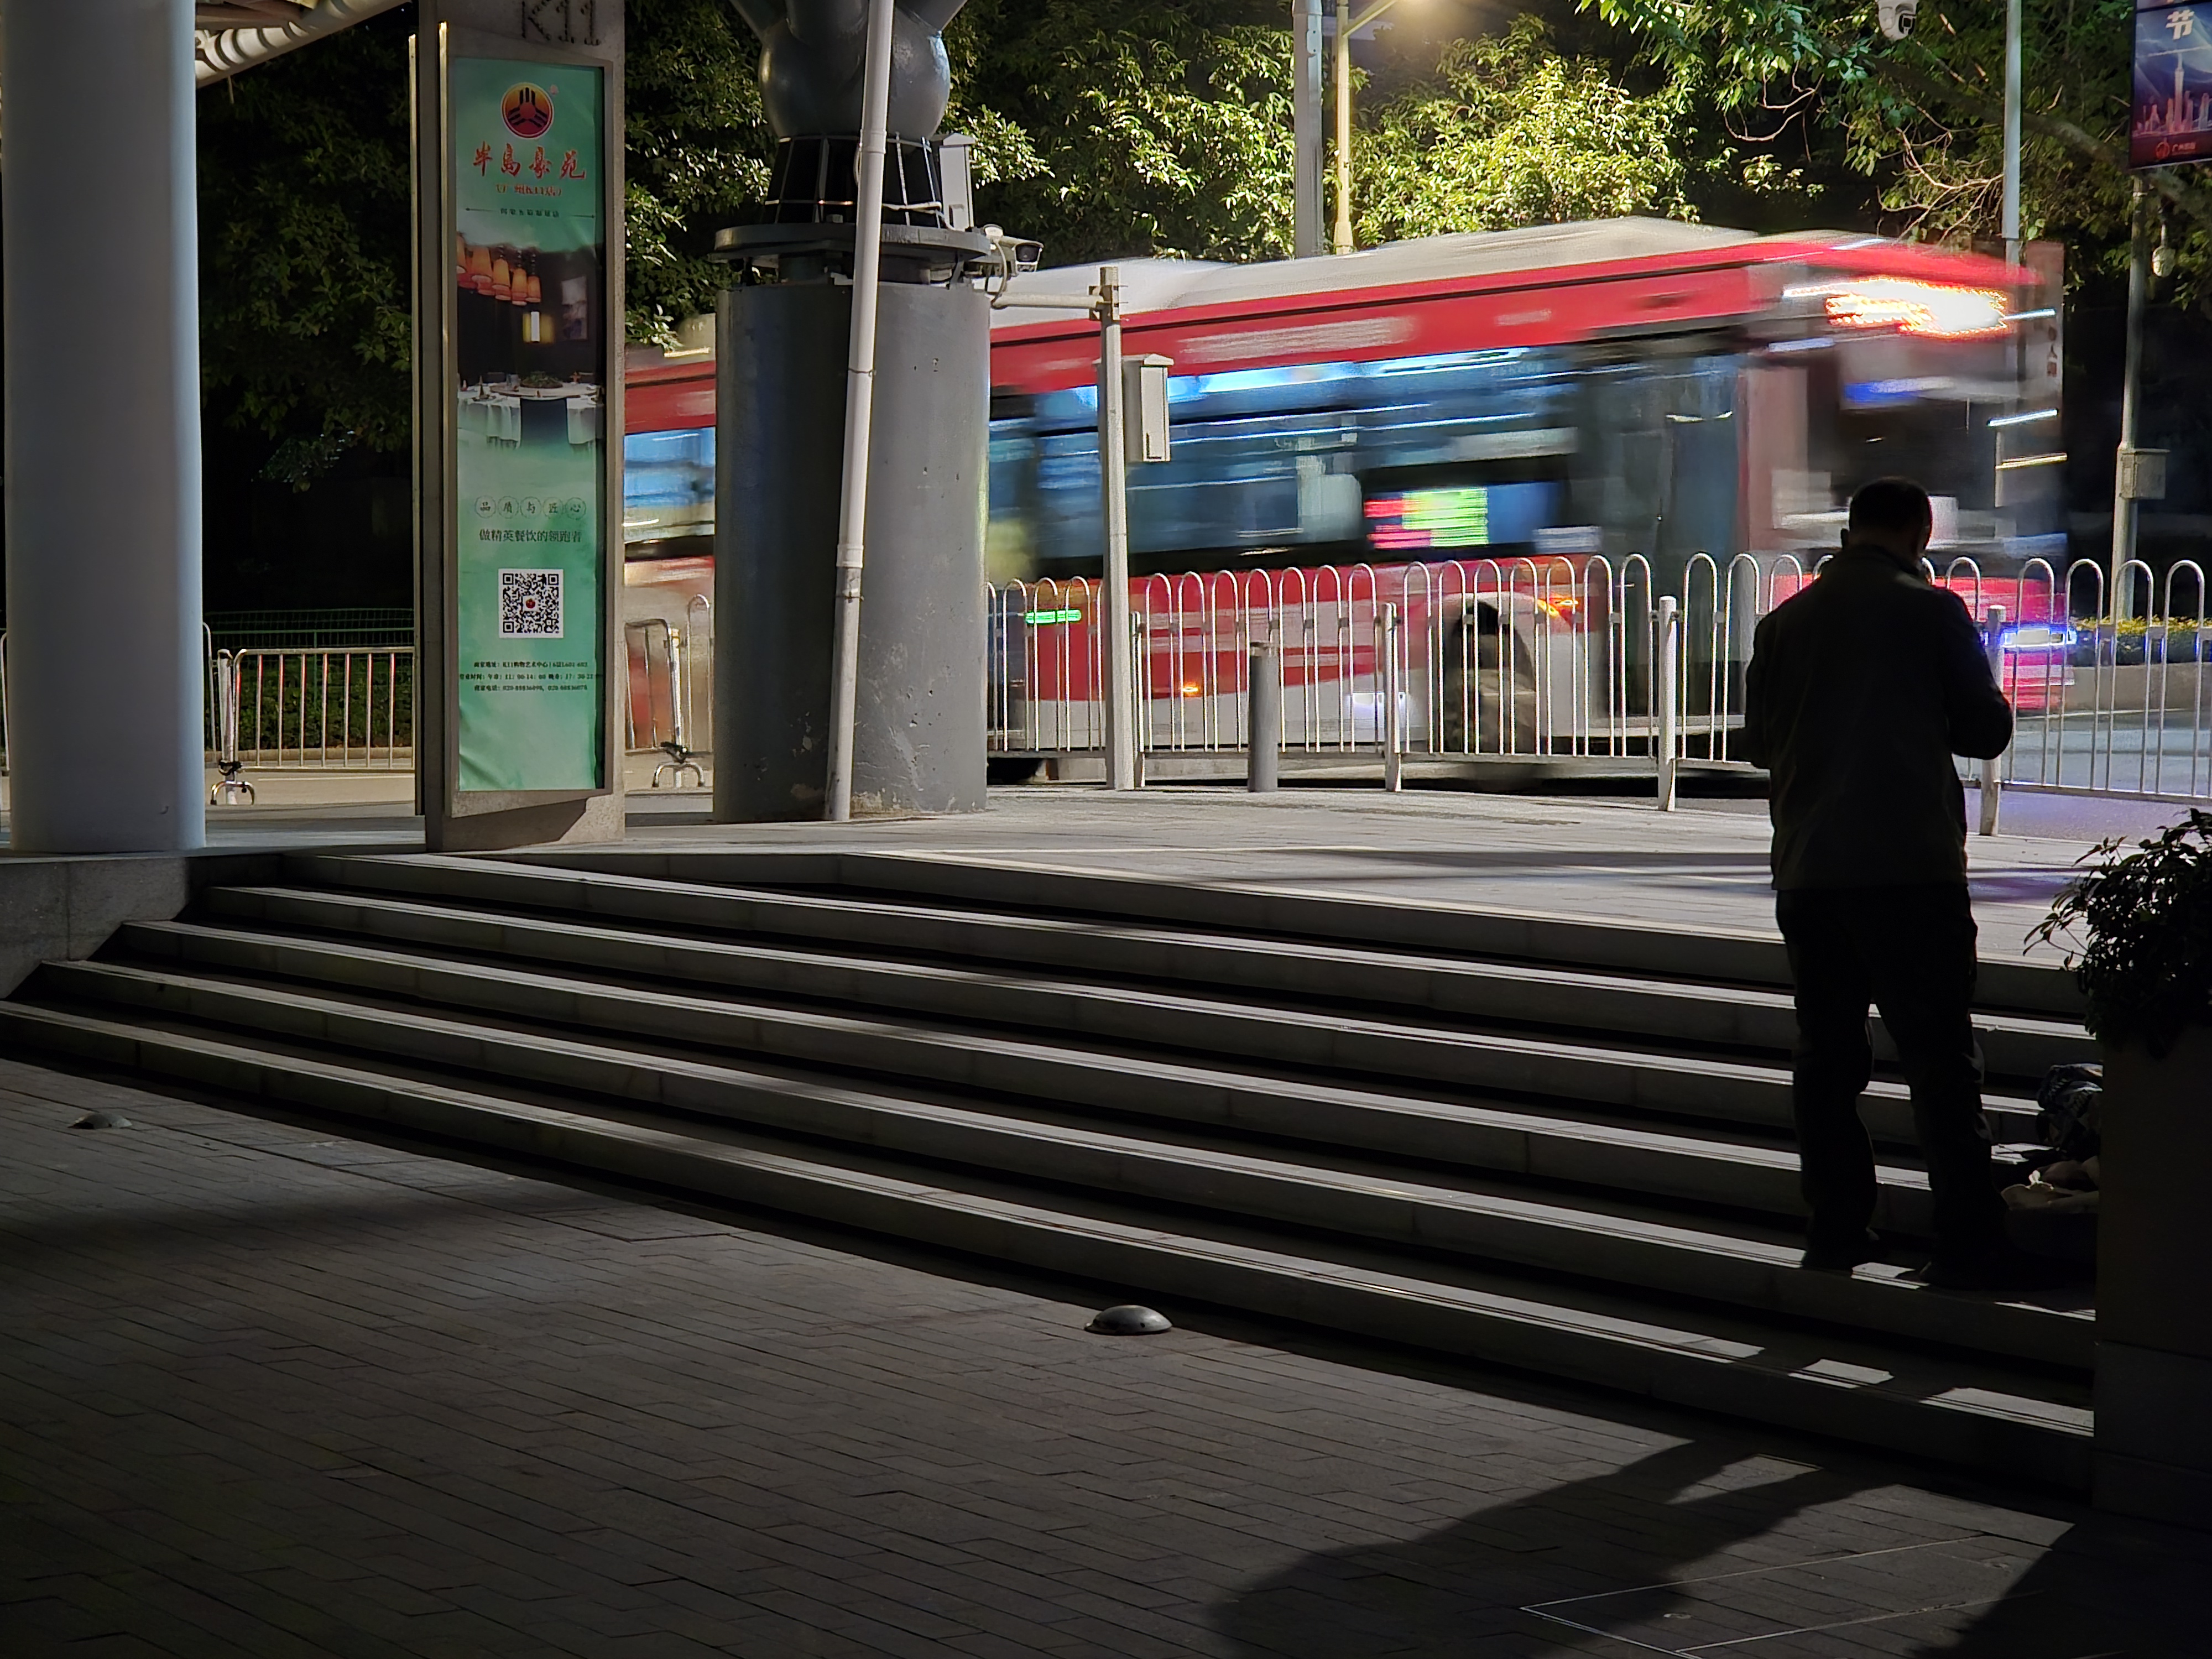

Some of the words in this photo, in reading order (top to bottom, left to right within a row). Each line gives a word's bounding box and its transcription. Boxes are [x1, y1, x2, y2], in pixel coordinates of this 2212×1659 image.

[521, 0, 602, 46] K11
[2166, 9, 2194, 40] 节
[479, 529, 581, 542] 做精英餐饮的领跑者
